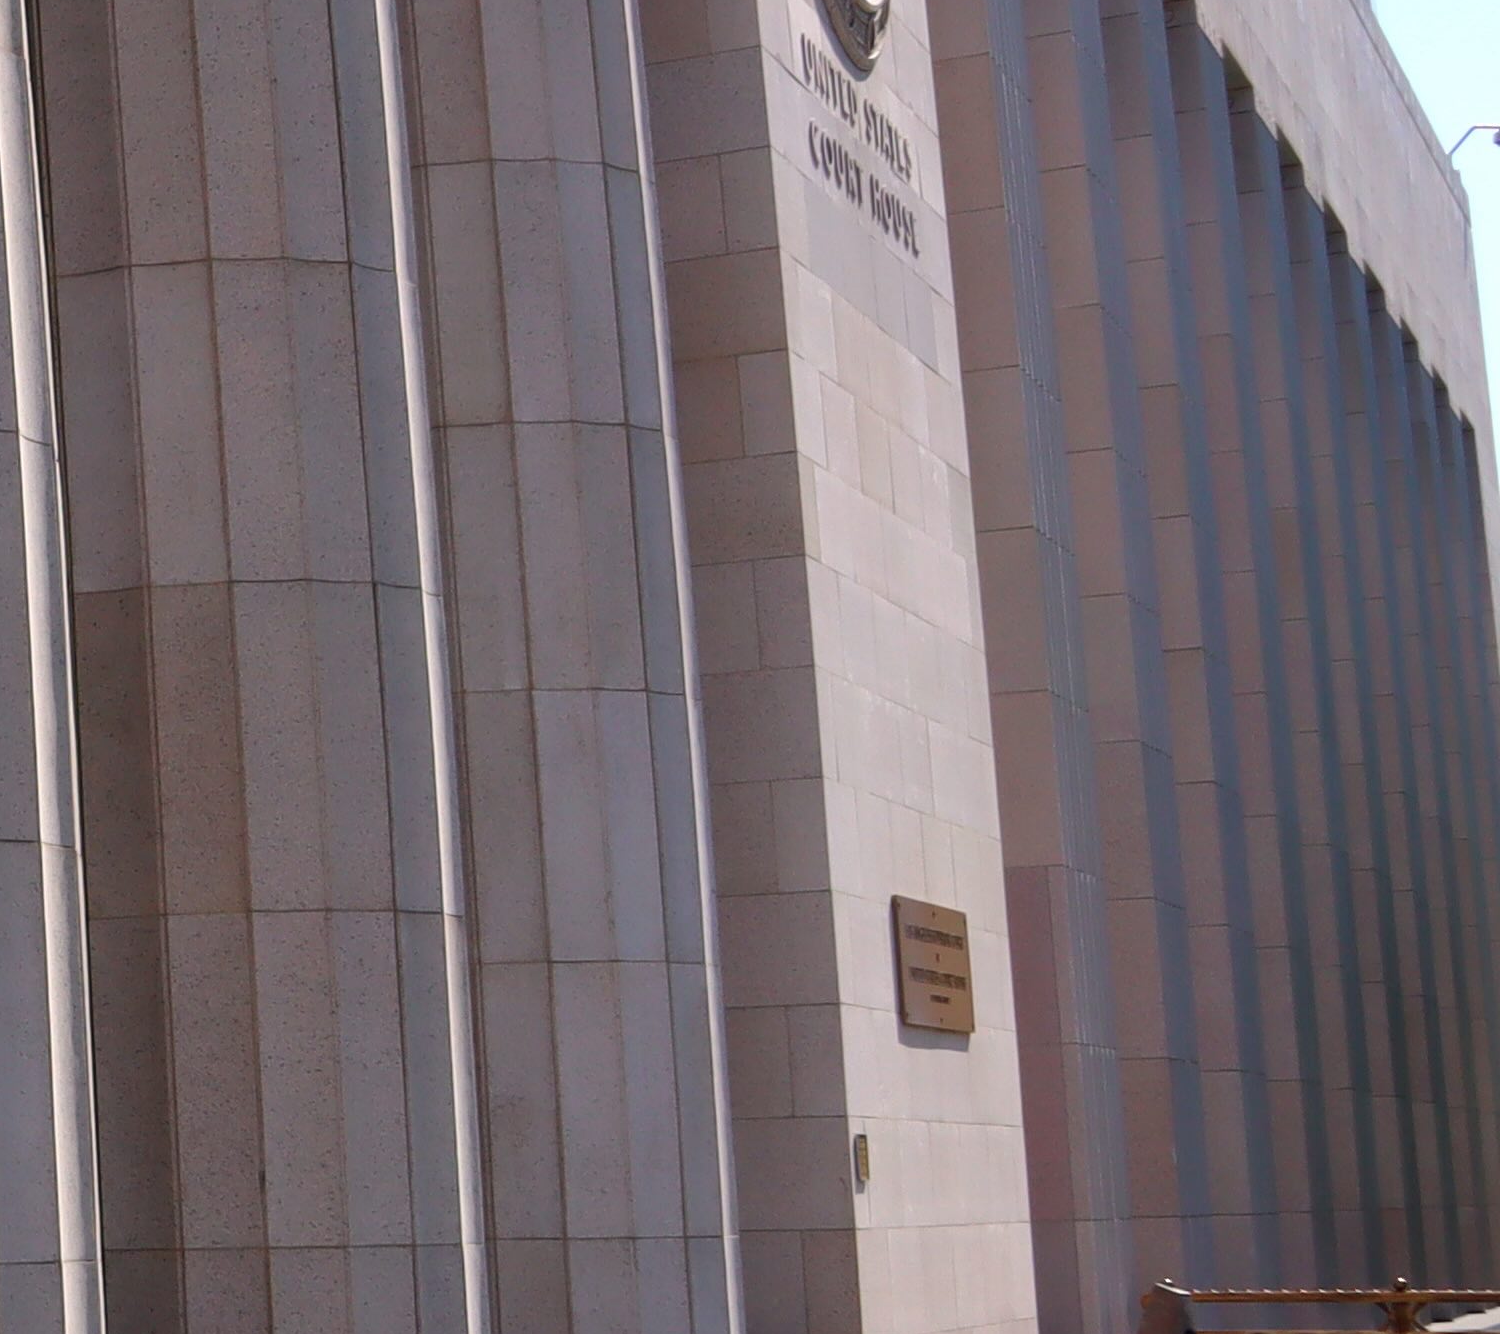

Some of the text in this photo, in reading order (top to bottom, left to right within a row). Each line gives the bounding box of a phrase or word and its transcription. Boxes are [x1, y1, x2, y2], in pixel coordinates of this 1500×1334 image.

[801, 33, 911, 182] UNITED STATES
[809, 121, 919, 259] COURT HOUSE
